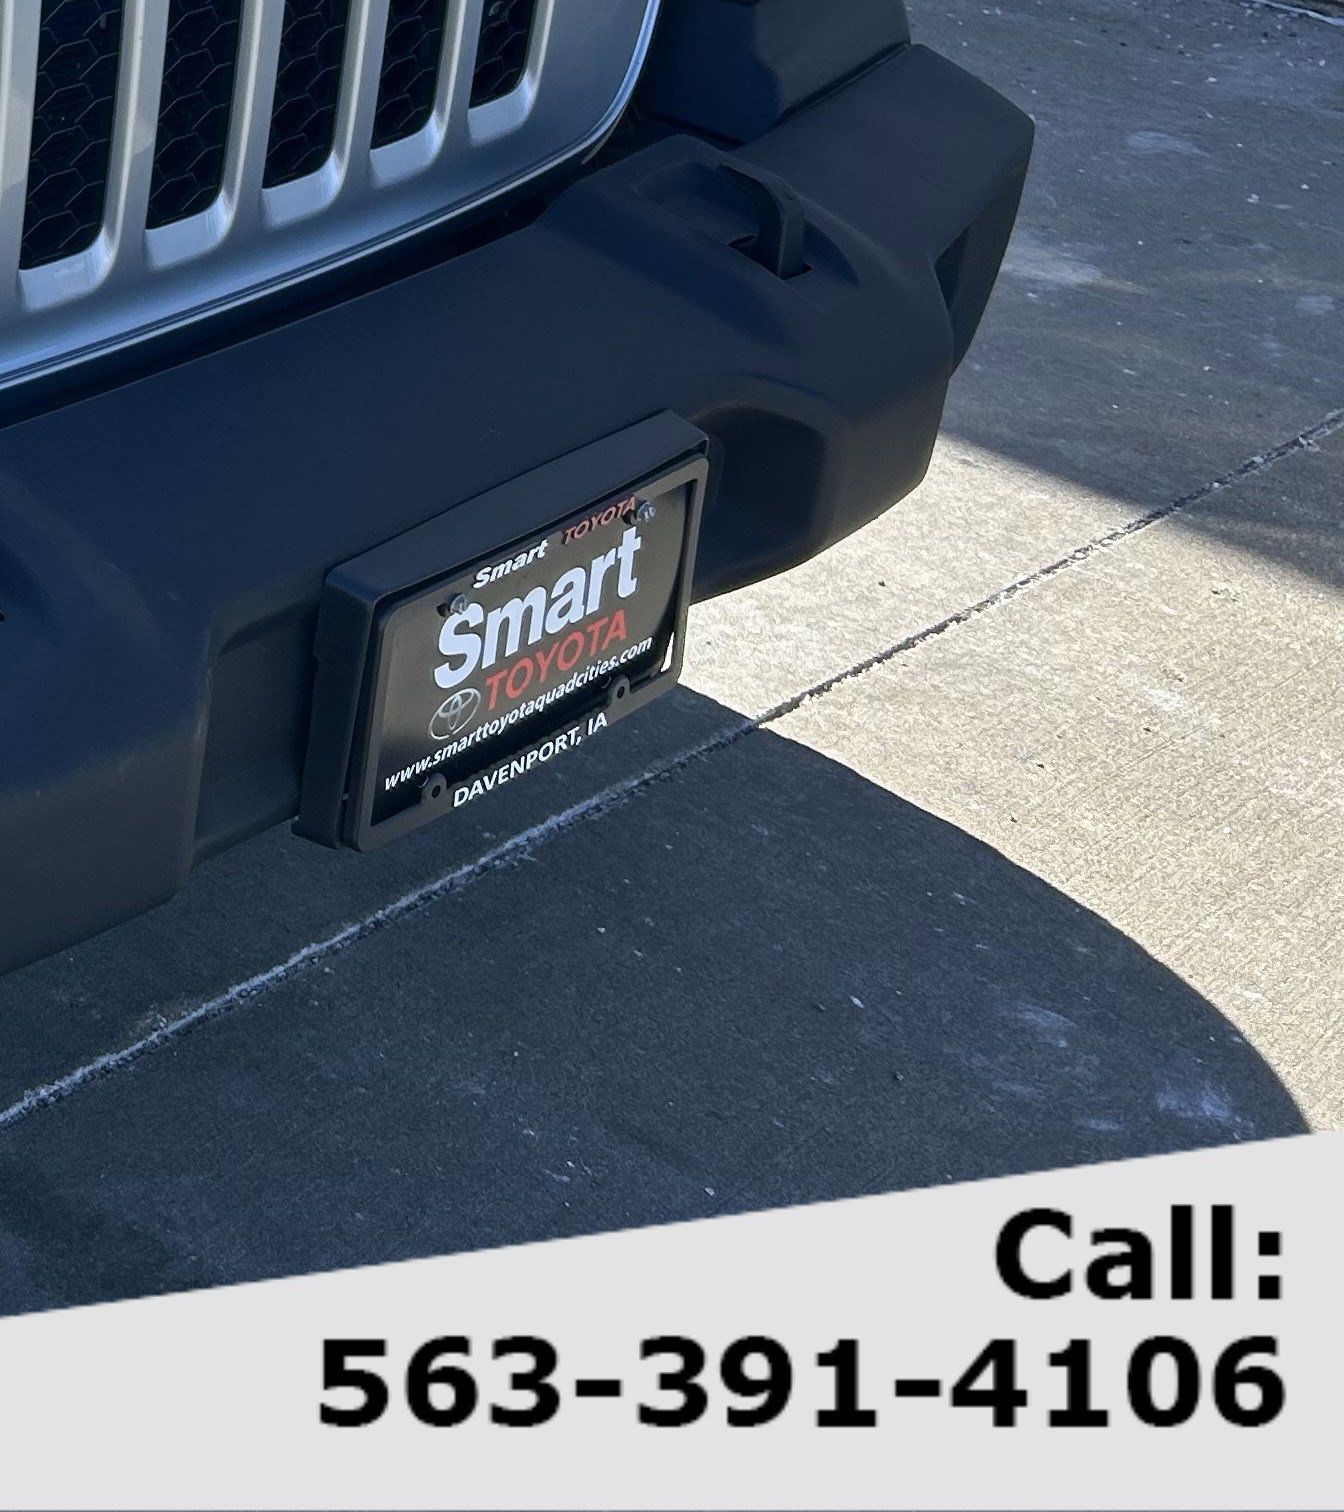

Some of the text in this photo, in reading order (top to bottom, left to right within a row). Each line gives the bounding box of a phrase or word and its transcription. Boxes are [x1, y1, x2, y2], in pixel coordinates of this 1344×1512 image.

[472, 496, 635, 589] Smart TOYOTA
[434, 526, 642, 689] Smart
[485, 609, 627, 711] TOYOTA
[384, 637, 653, 790] www.smarttoyotaquadcities.com
[453, 712, 609, 807] DAVENPORT, IA
